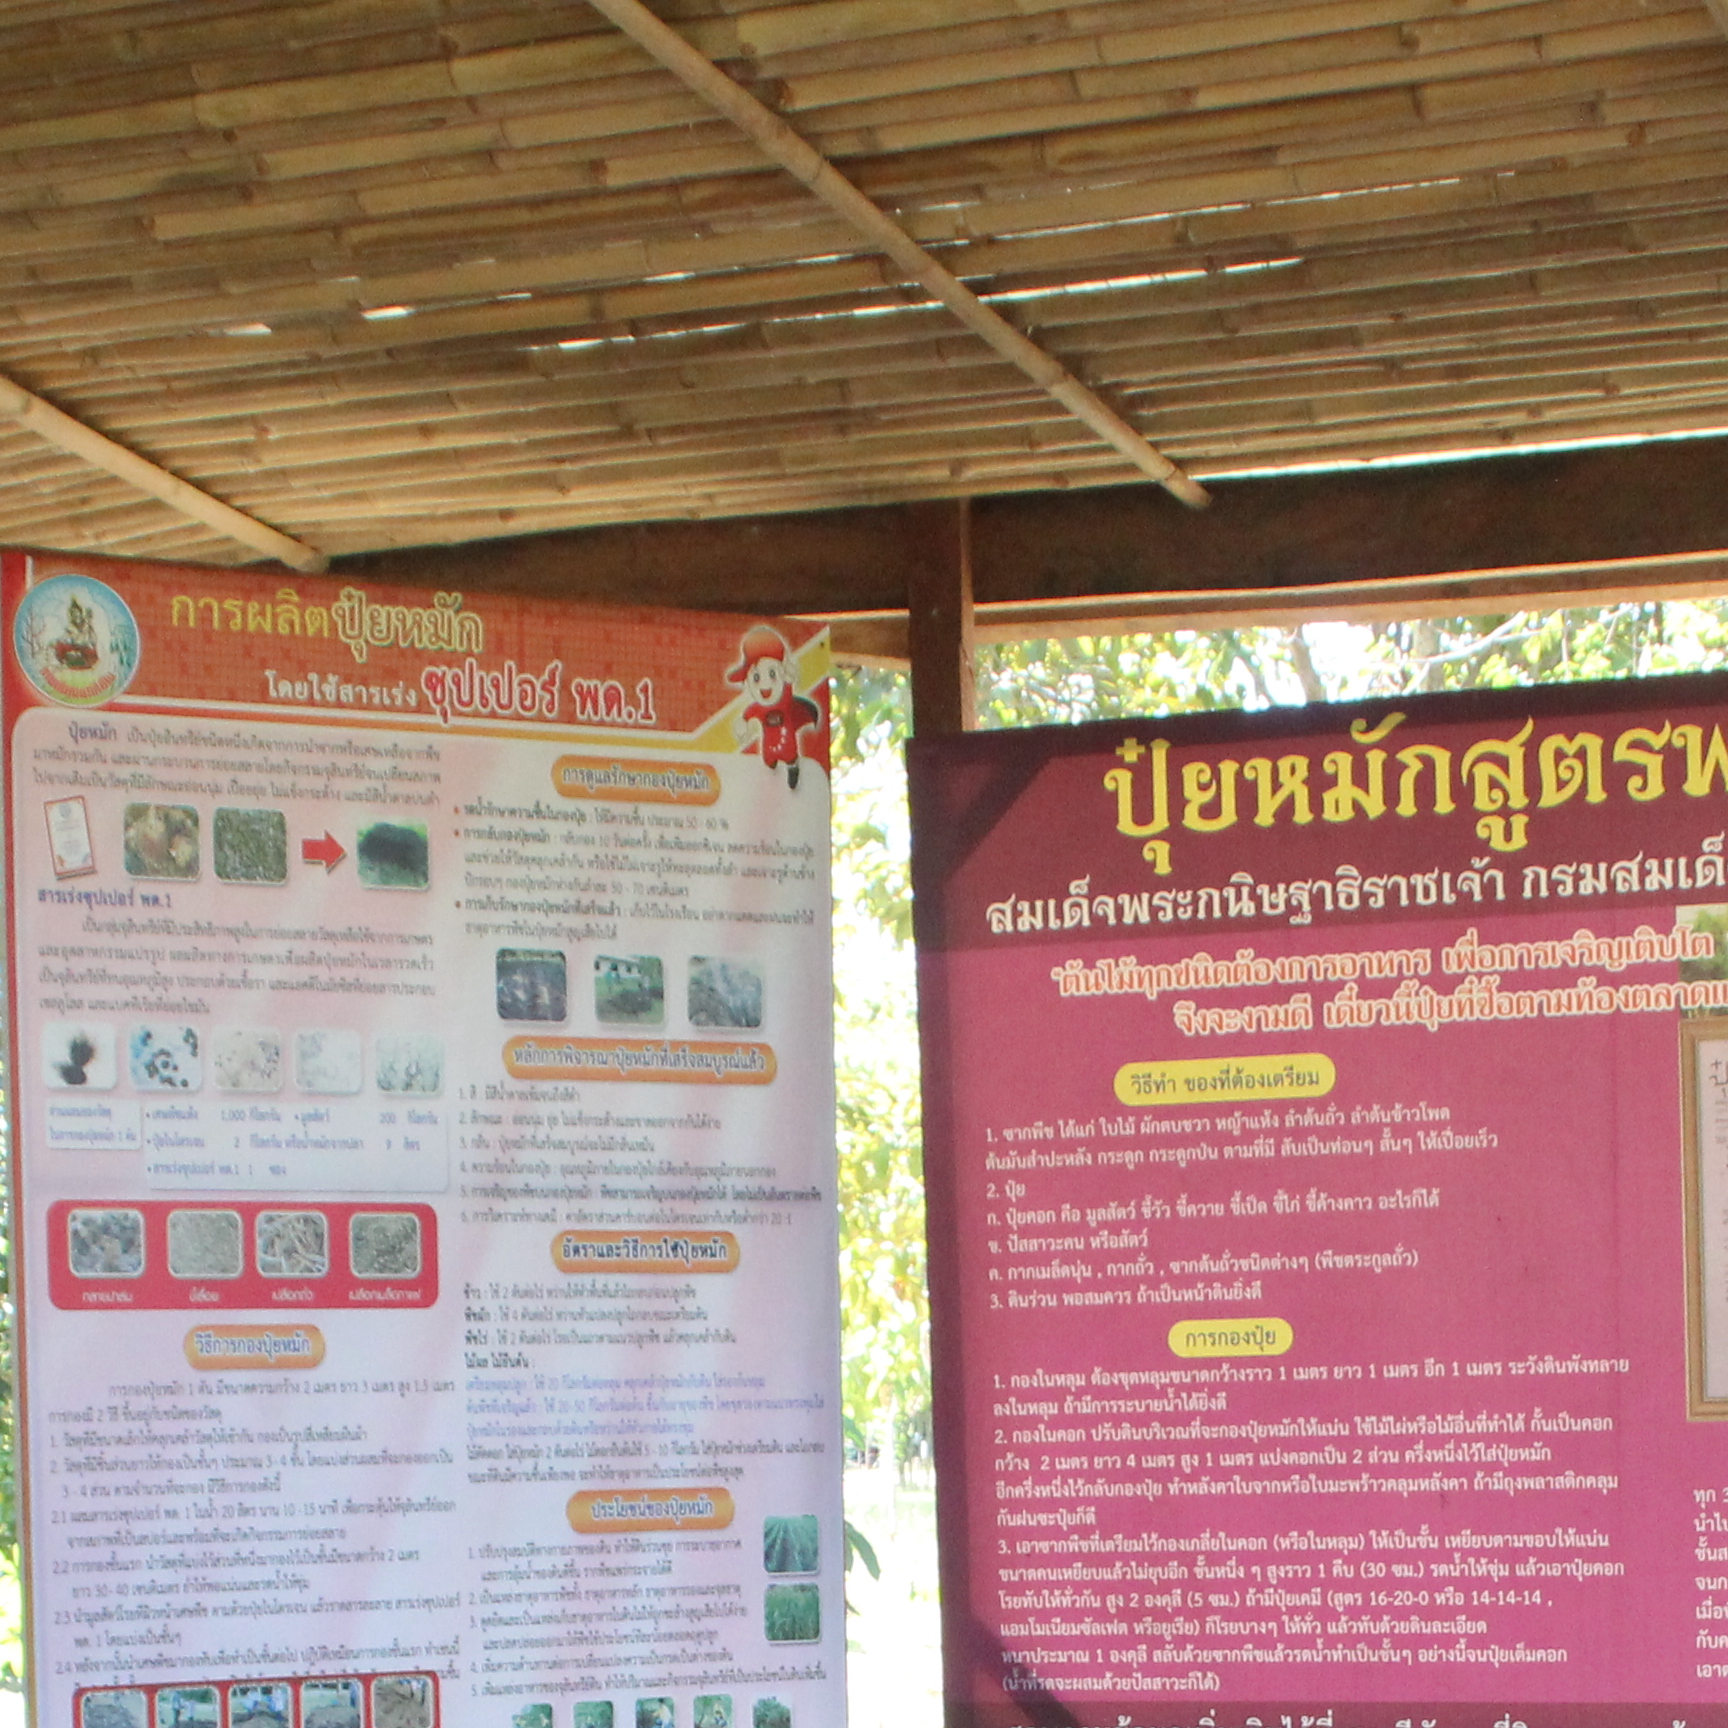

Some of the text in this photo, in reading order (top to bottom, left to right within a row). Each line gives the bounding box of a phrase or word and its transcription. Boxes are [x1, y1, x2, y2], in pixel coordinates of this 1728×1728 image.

[171, 586, 485, 663] การผลิตปุ๋ยหมัก
[264, 658, 657, 725] โดยใช้สารเร่ง ซุปเปอร์ พด.1
[69, 720, 117, 745] ปุ๋ยหมัก
[985, 856, 1506, 934] สมเด็จพระกนิษฐาธิราชเจ้า
[1441, 926, 1714, 972] เพื่อการเจริญเติบโต
[1173, 994, 1313, 1036] จึงจะงามดี
[1130, 1066, 1320, 1095] วิธีทำ ของที่ต้องเตรียม
[986, 1101, 1451, 1143] 1. ซากพืช ได้แก่ ใบไม้ ผักตบชวา หญ้าแห้ง ลำต้นถั่ว ลำต้นข้าวโพด
[985, 1126, 1498, 1170] ต้นมันสำปะหลัง กระดูก กระดูกป่น ตามที่มี สับเป็นท่อนๆ สั้นๆ ให้เปื่อยเร็ว
[986, 1179, 1026, 1204] 2. ปุ๋ย
[987, 1187, 1440, 1231] ก. ปุ๋ยคอก คือ มูลสัตว์ ขี้วัว ขี้ควาย ขี้เป็ด ขี้ไก่ ขี้ค้างคาว อะไรก็ได้
[987, 1227, 1149, 1254] ข. ปัสสาวะคน หรือสัตว์
[990, 1279, 1262, 1309] 3. ดินร่วน พอสมควร ถ้าเป็นหน้าดินยิ่งดี
[195, 1331, 310, 1362] วิธีการกองปุ๋ยหมัก
[1185, 1324, 1276, 1351] การกองปุ๋ย
[993, 1389, 1227, 1421] ลงในหลุม ถ้ามีการระบายน้ำได้ยิ่งดี
[591, 1495, 714, 1526] ประโยชน์ของปุ๋ยหมัก
[1693, 1489, 1717, 1510] ทุก
